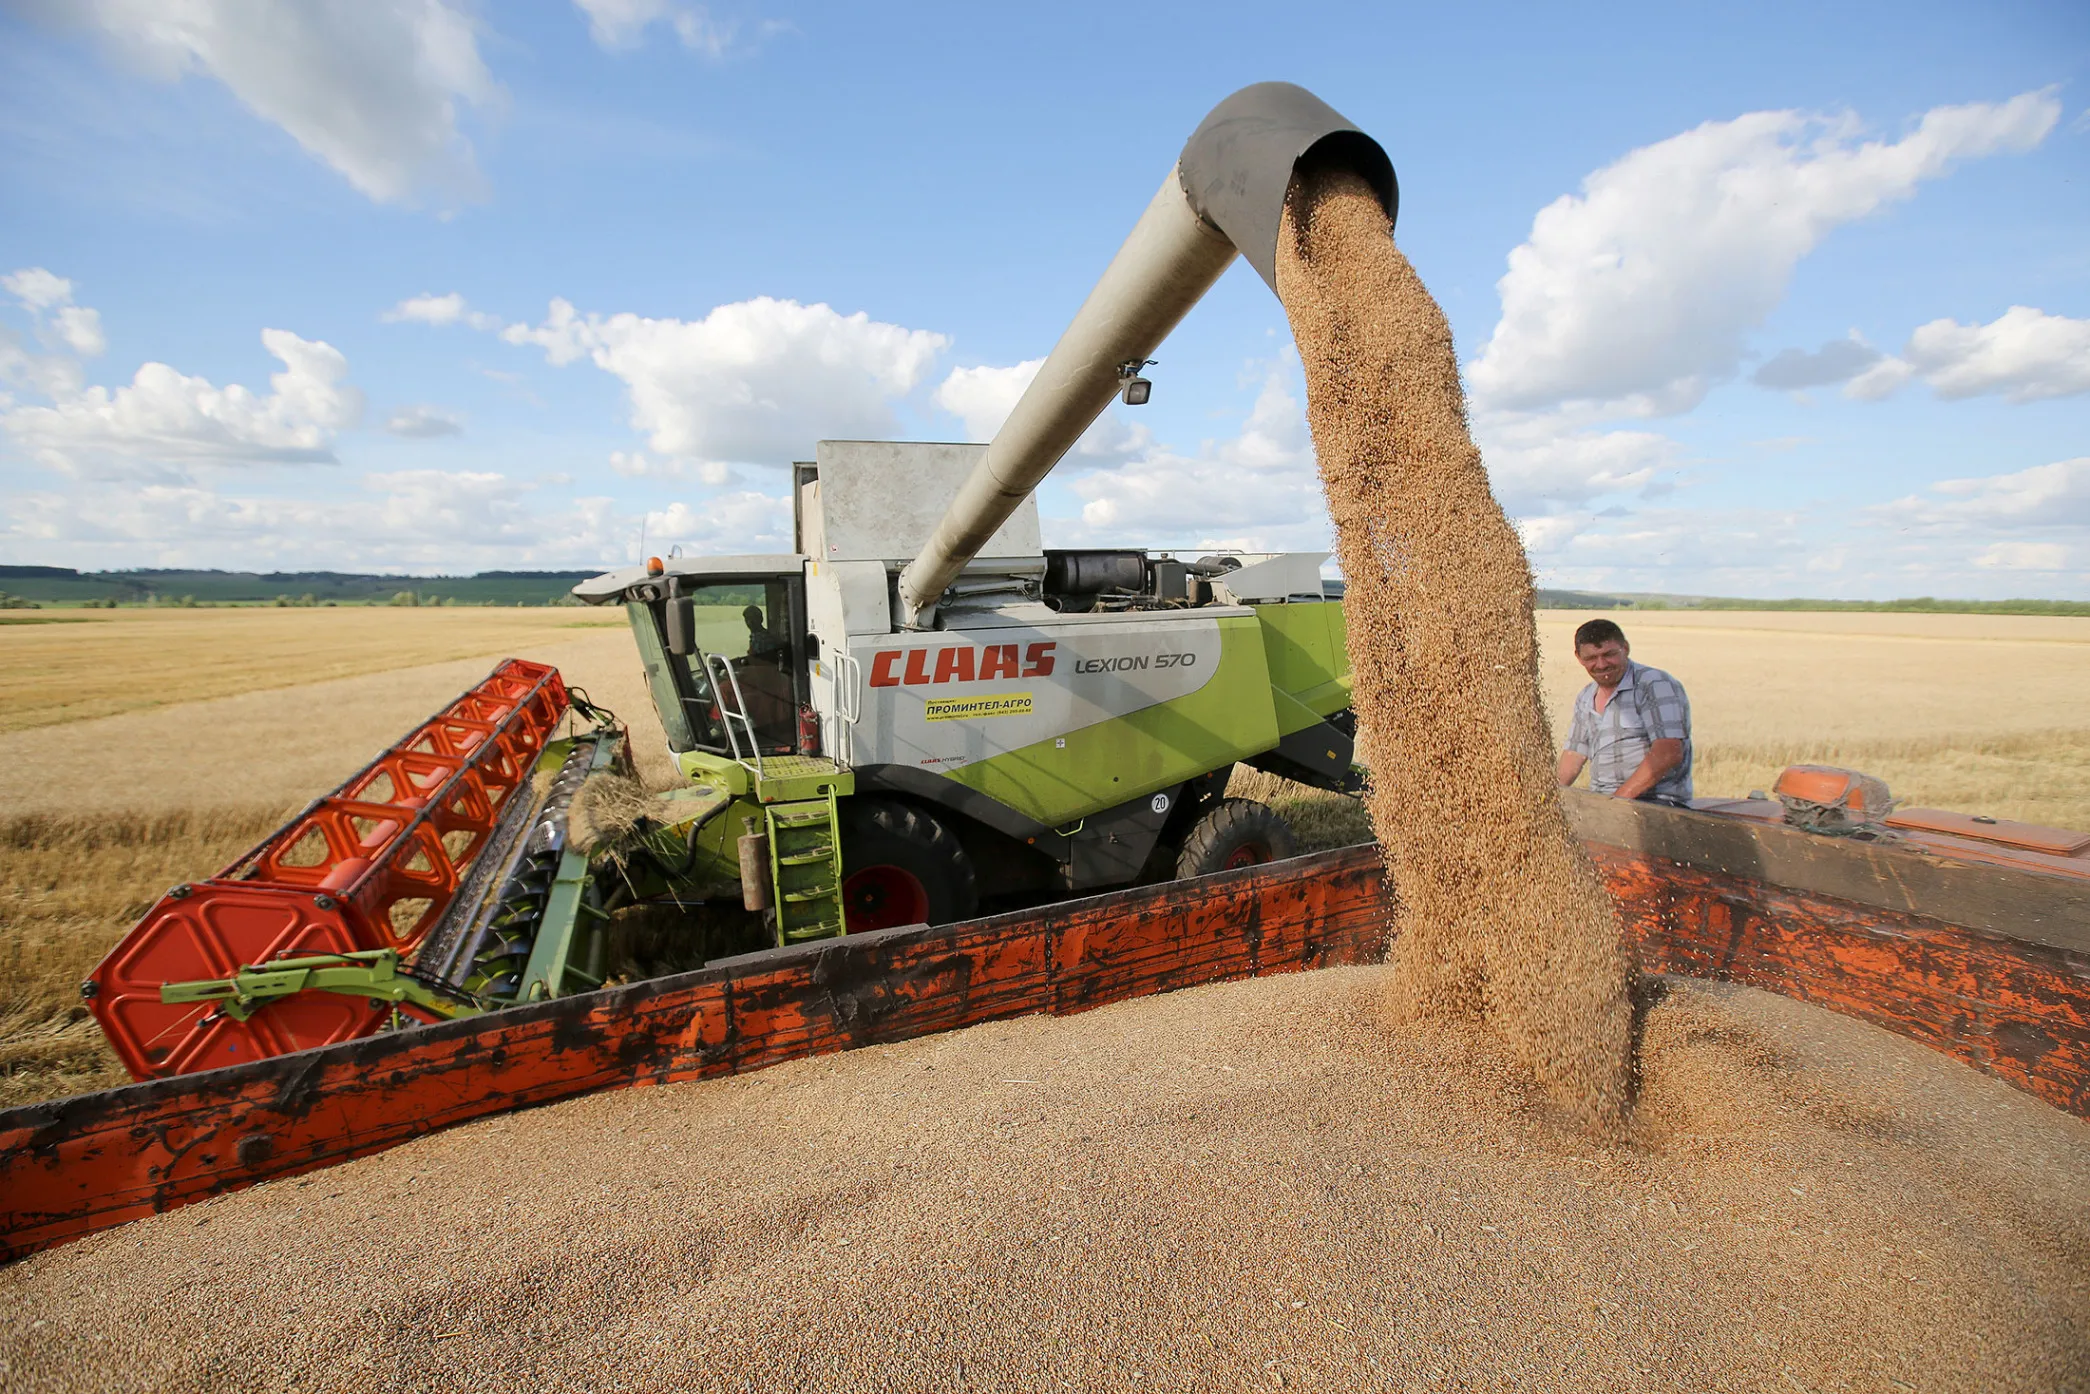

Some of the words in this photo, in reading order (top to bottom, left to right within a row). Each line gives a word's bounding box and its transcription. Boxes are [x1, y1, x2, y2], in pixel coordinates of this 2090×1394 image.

[869, 642, 1057, 688] CLAAS
[1075, 655, 1150, 674] LEXION
[1154, 653, 1196, 669] 570
[926, 698, 1032, 715] ПРОМИНТЕЛ-АГРО
[1154, 796, 1166, 810] 20
